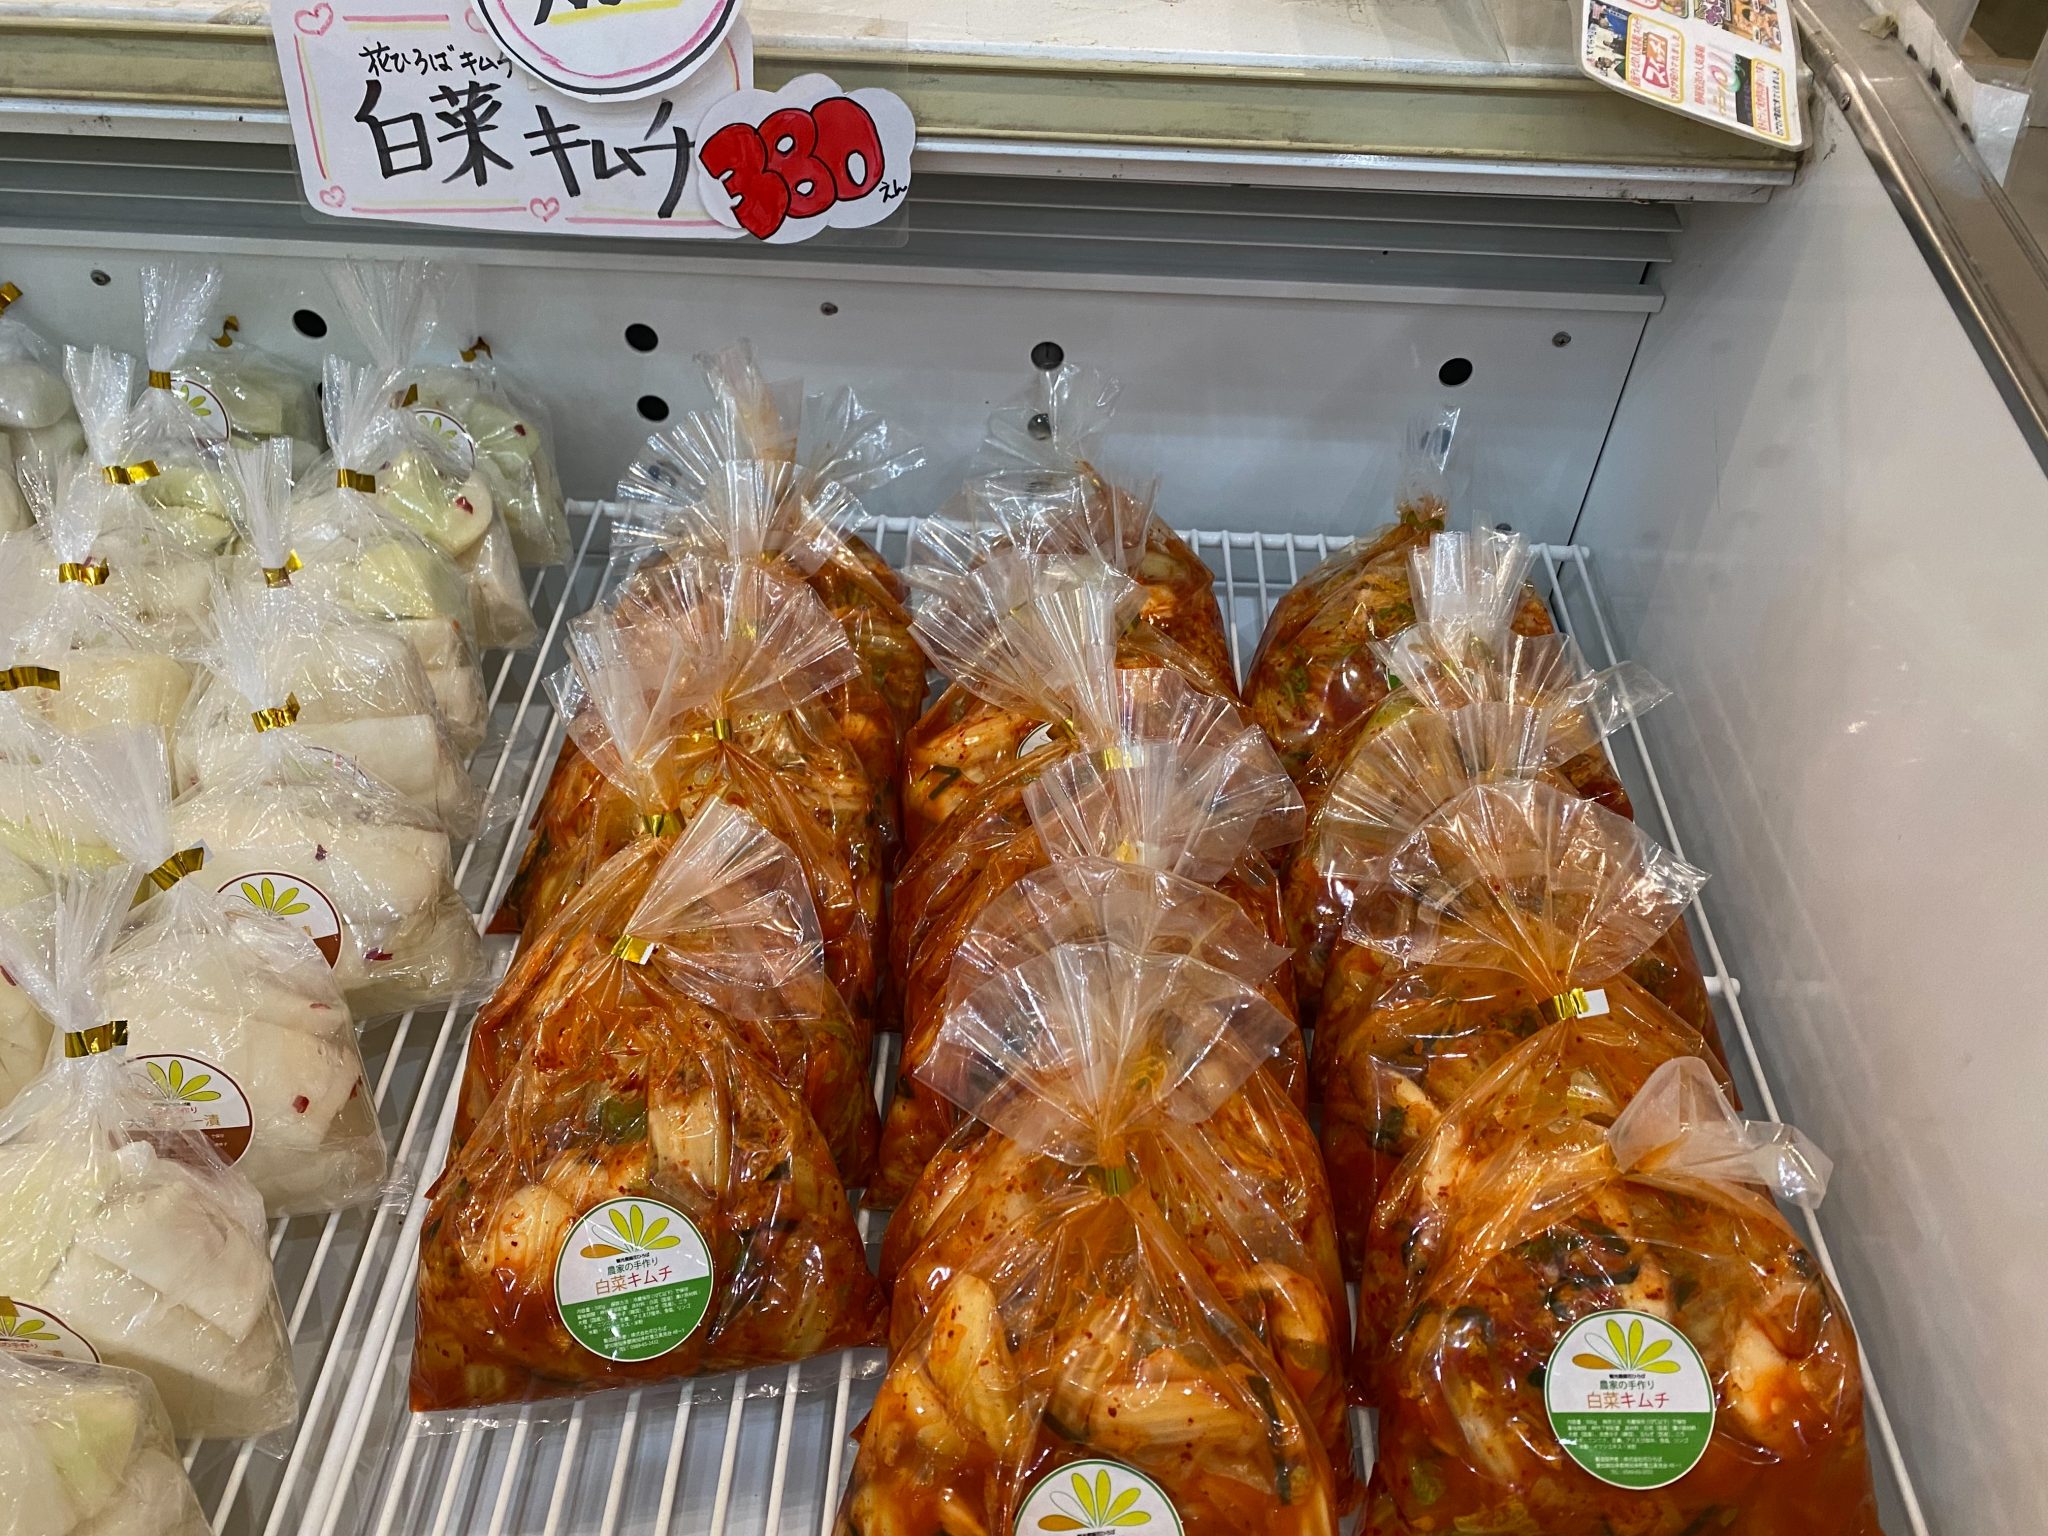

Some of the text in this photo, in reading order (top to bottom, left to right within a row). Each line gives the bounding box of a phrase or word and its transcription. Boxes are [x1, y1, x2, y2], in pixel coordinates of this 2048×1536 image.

[354, 79, 696, 219] 白菜キムチ
[699, 96, 908, 240] 380 えん
[607, 1256, 659, 1276] 農家の手作り
[595, 1265, 673, 1296] 白菜キムチ
[1600, 1380, 1655, 1391] 農家の手作り
[1587, 1392, 1670, 1409] 白菜キムチ
